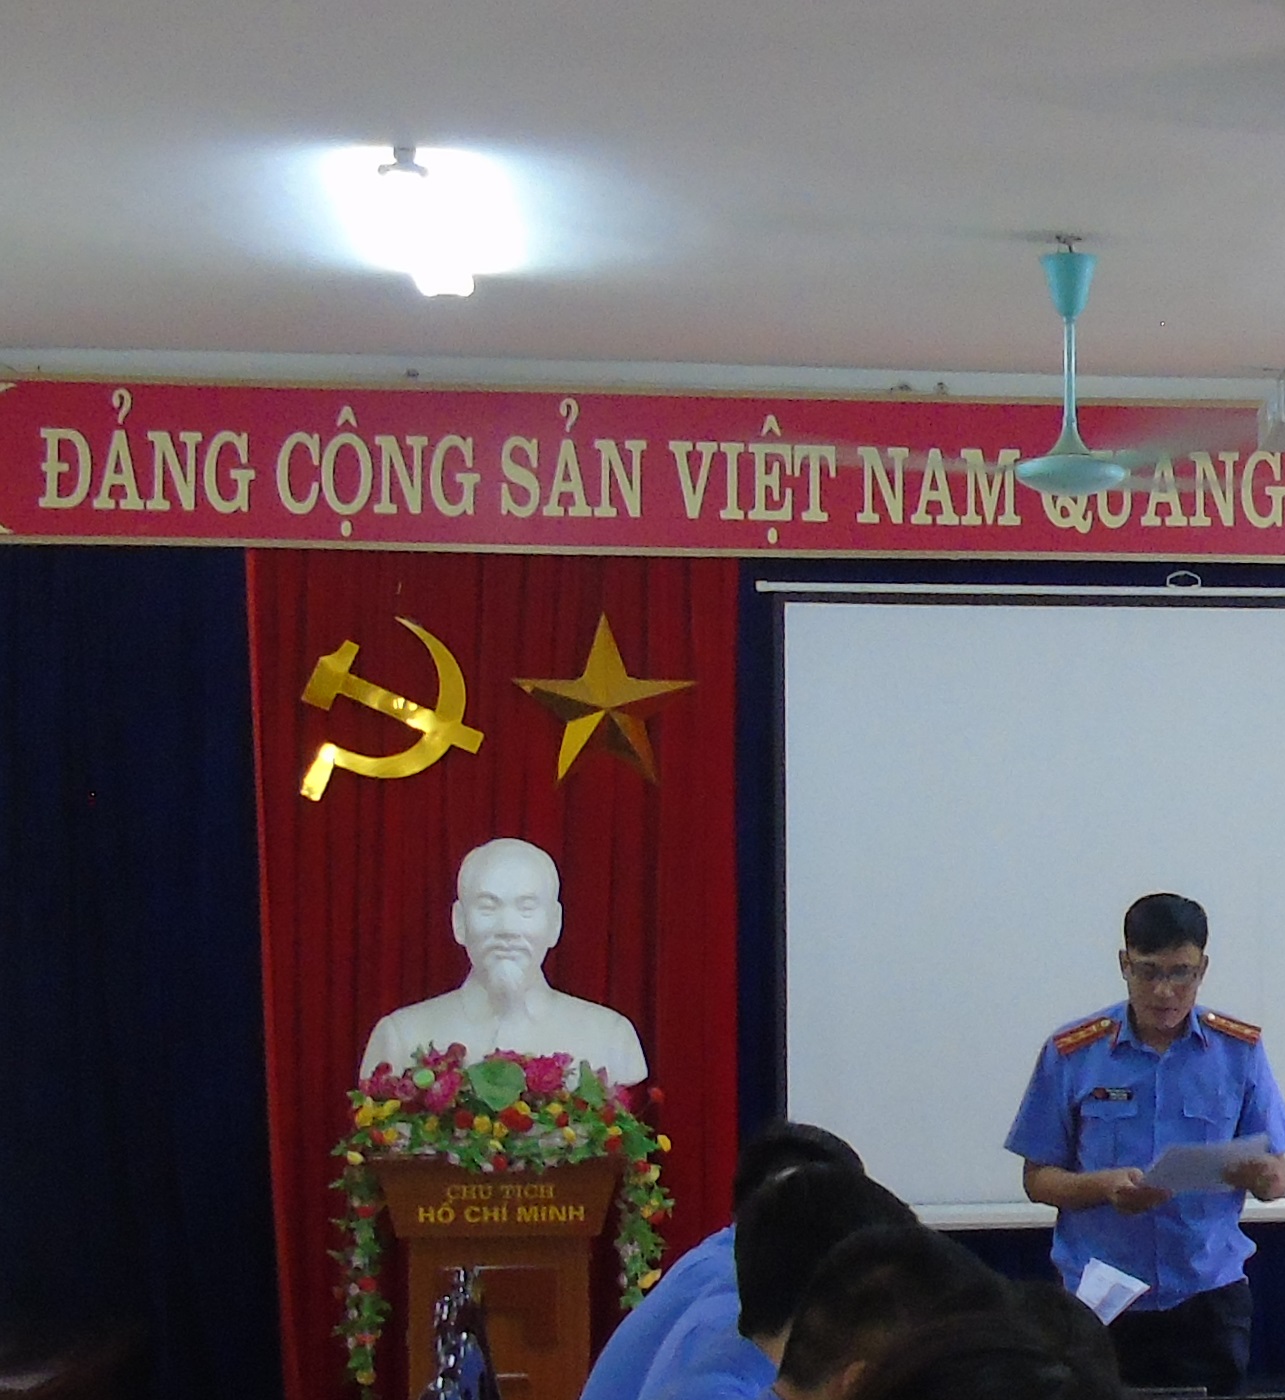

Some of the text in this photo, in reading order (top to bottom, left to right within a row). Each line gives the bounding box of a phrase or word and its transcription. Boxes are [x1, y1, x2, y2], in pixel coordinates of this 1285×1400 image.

[38, 387, 257, 515] ĐẢNG
[276, 405, 481, 537] CỘNG
[500, 397, 648, 519] SẢN
[669, 413, 837, 545] VIỆT
[856, 446, 1022, 527] NAM
[516, 1205, 585, 1222] MINH
